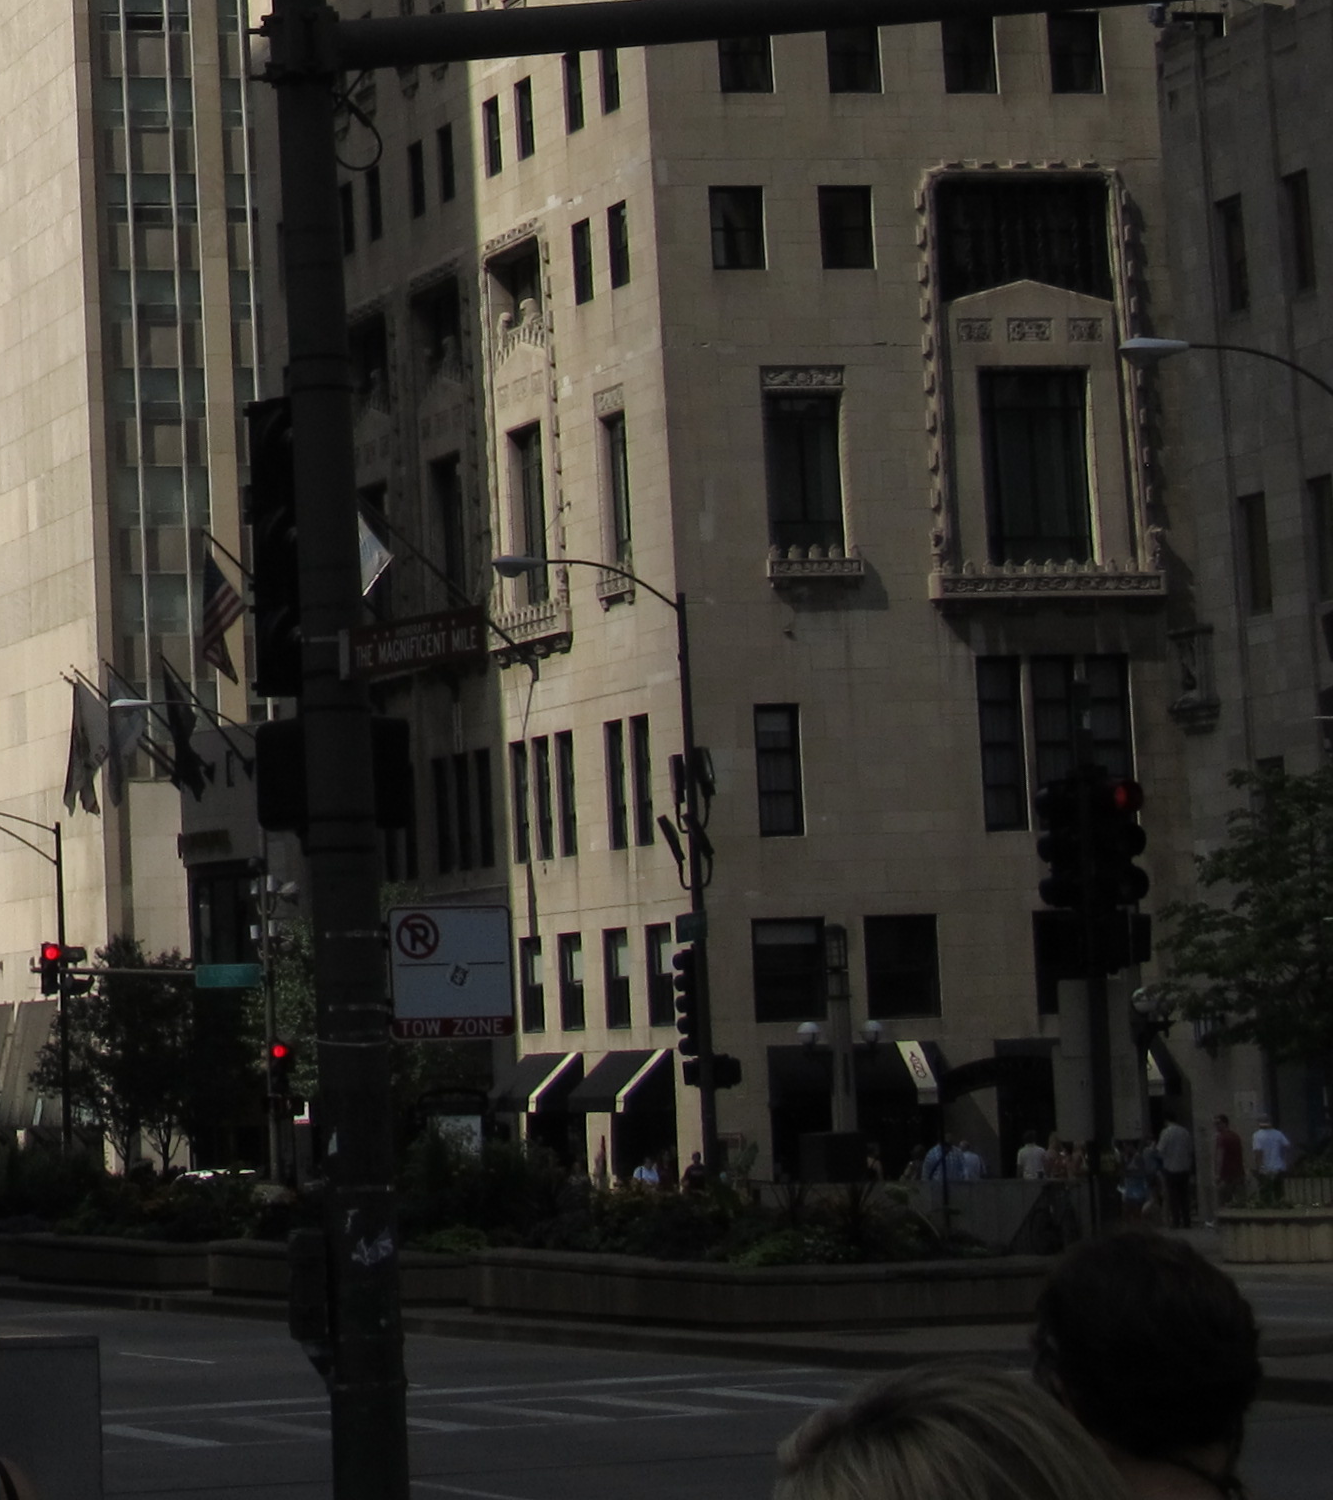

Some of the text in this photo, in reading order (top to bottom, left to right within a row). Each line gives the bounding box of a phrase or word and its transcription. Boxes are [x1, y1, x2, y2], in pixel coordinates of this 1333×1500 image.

[355, 626, 478, 668] THE MAGNIFICENT MILE
[400, 1018, 504, 1037] TOW ZONE
